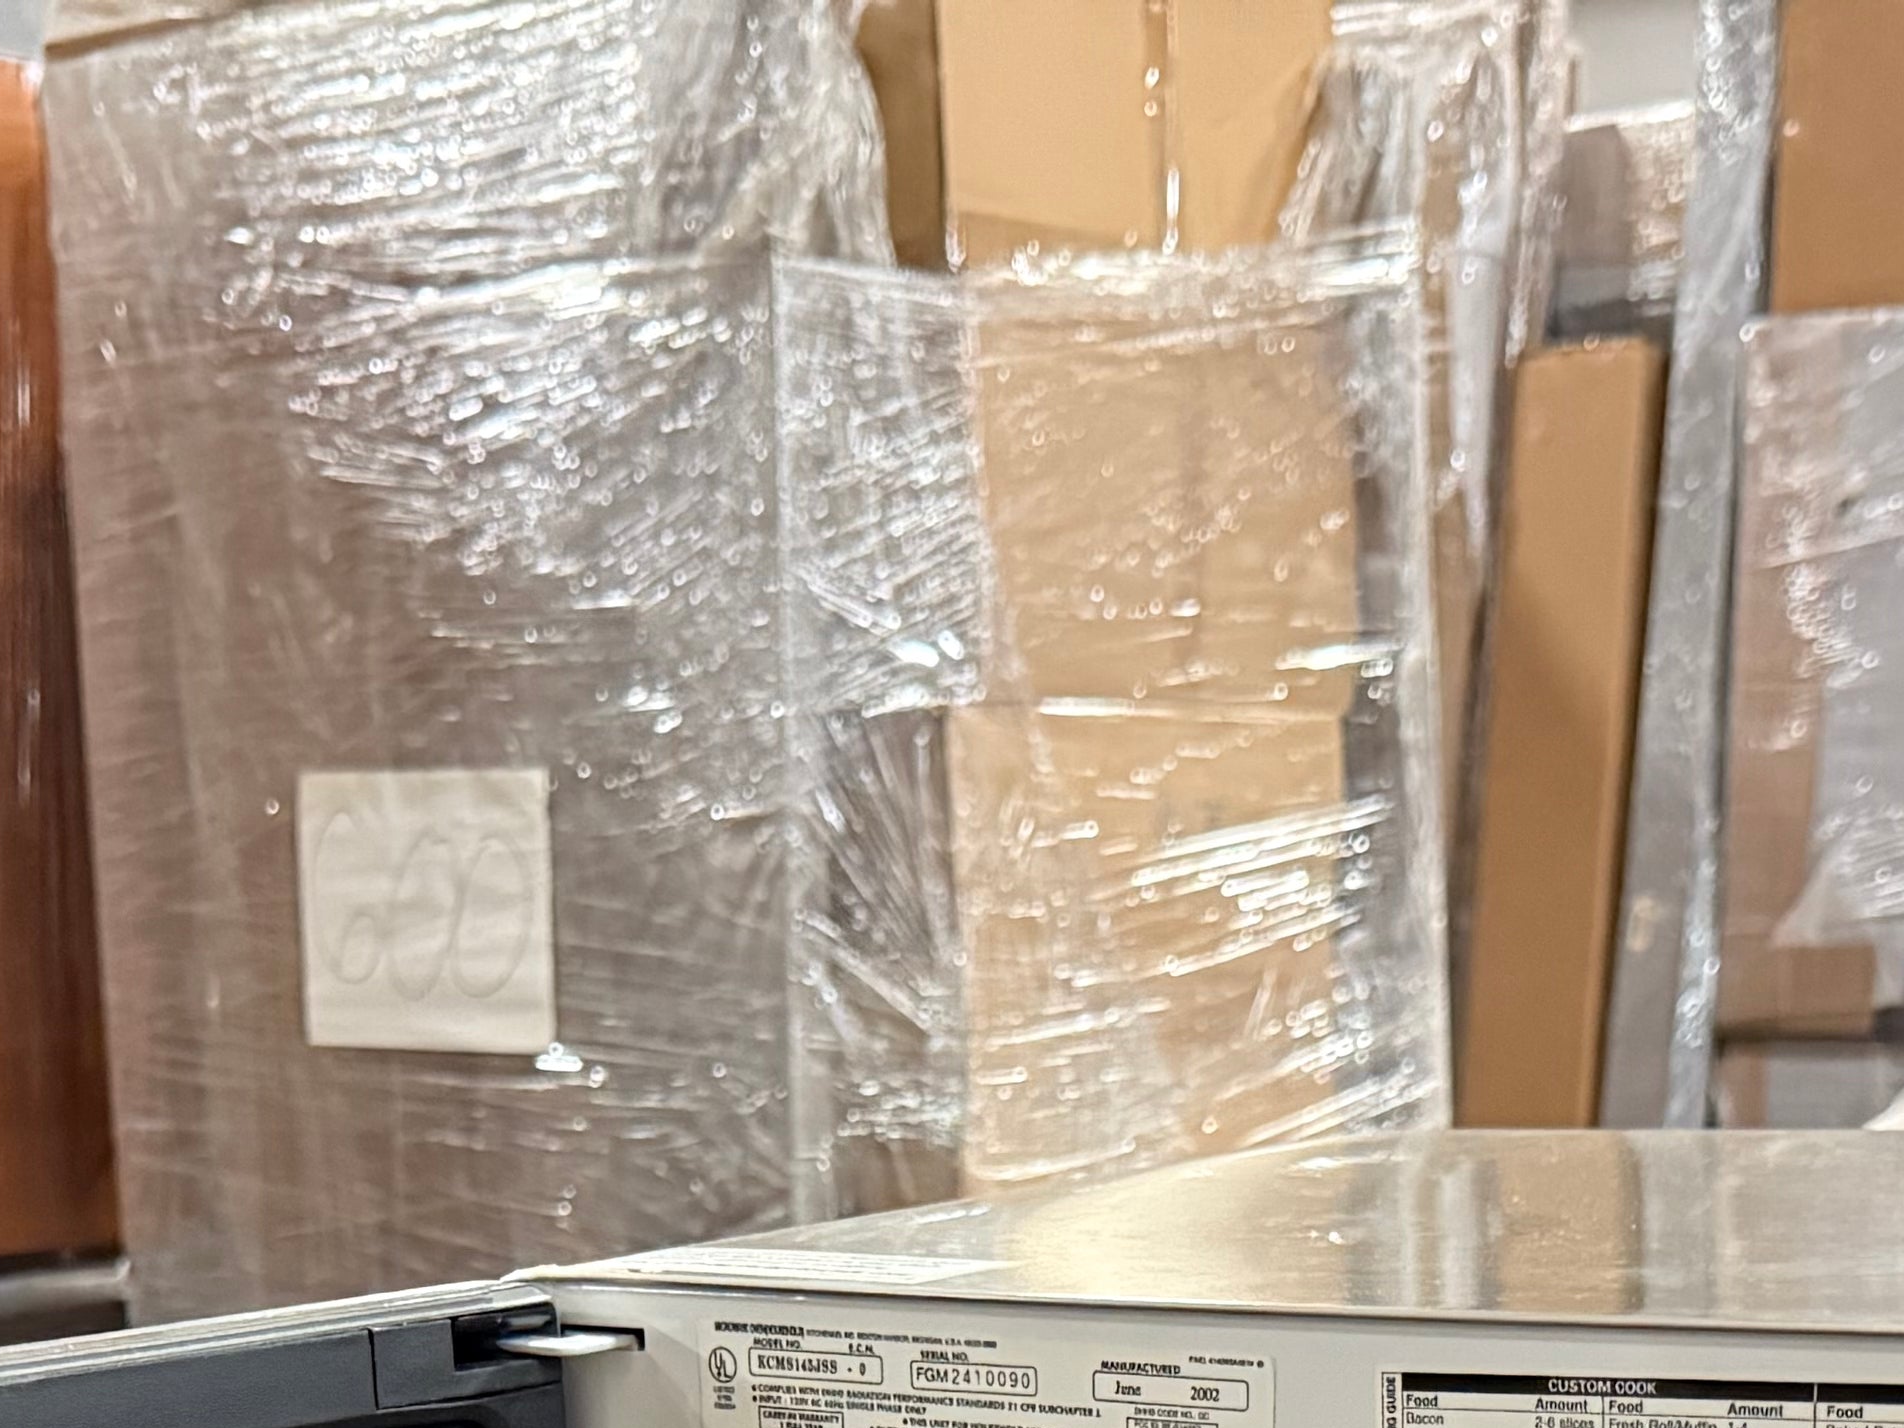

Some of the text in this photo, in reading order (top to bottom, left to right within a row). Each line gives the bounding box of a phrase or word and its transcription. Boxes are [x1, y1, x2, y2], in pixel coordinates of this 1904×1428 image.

[916, 1366, 1030, 1389] FGM2410090
[1548, 1379, 1657, 1394] CUSTOM COOK
[1115, 1380, 1220, 1402] June 2002
[1386, 1376, 1397, 1414] GUIDE
[1406, 1394, 1438, 1408] Food
[1534, 1397, 1588, 1412] Amount
[1608, 1399, 1643, 1413] Food
[1727, 1402, 1784, 1418] Amount
[1825, 1405, 1863, 1420] Food
[1406, 1412, 1444, 1425] Bacon
